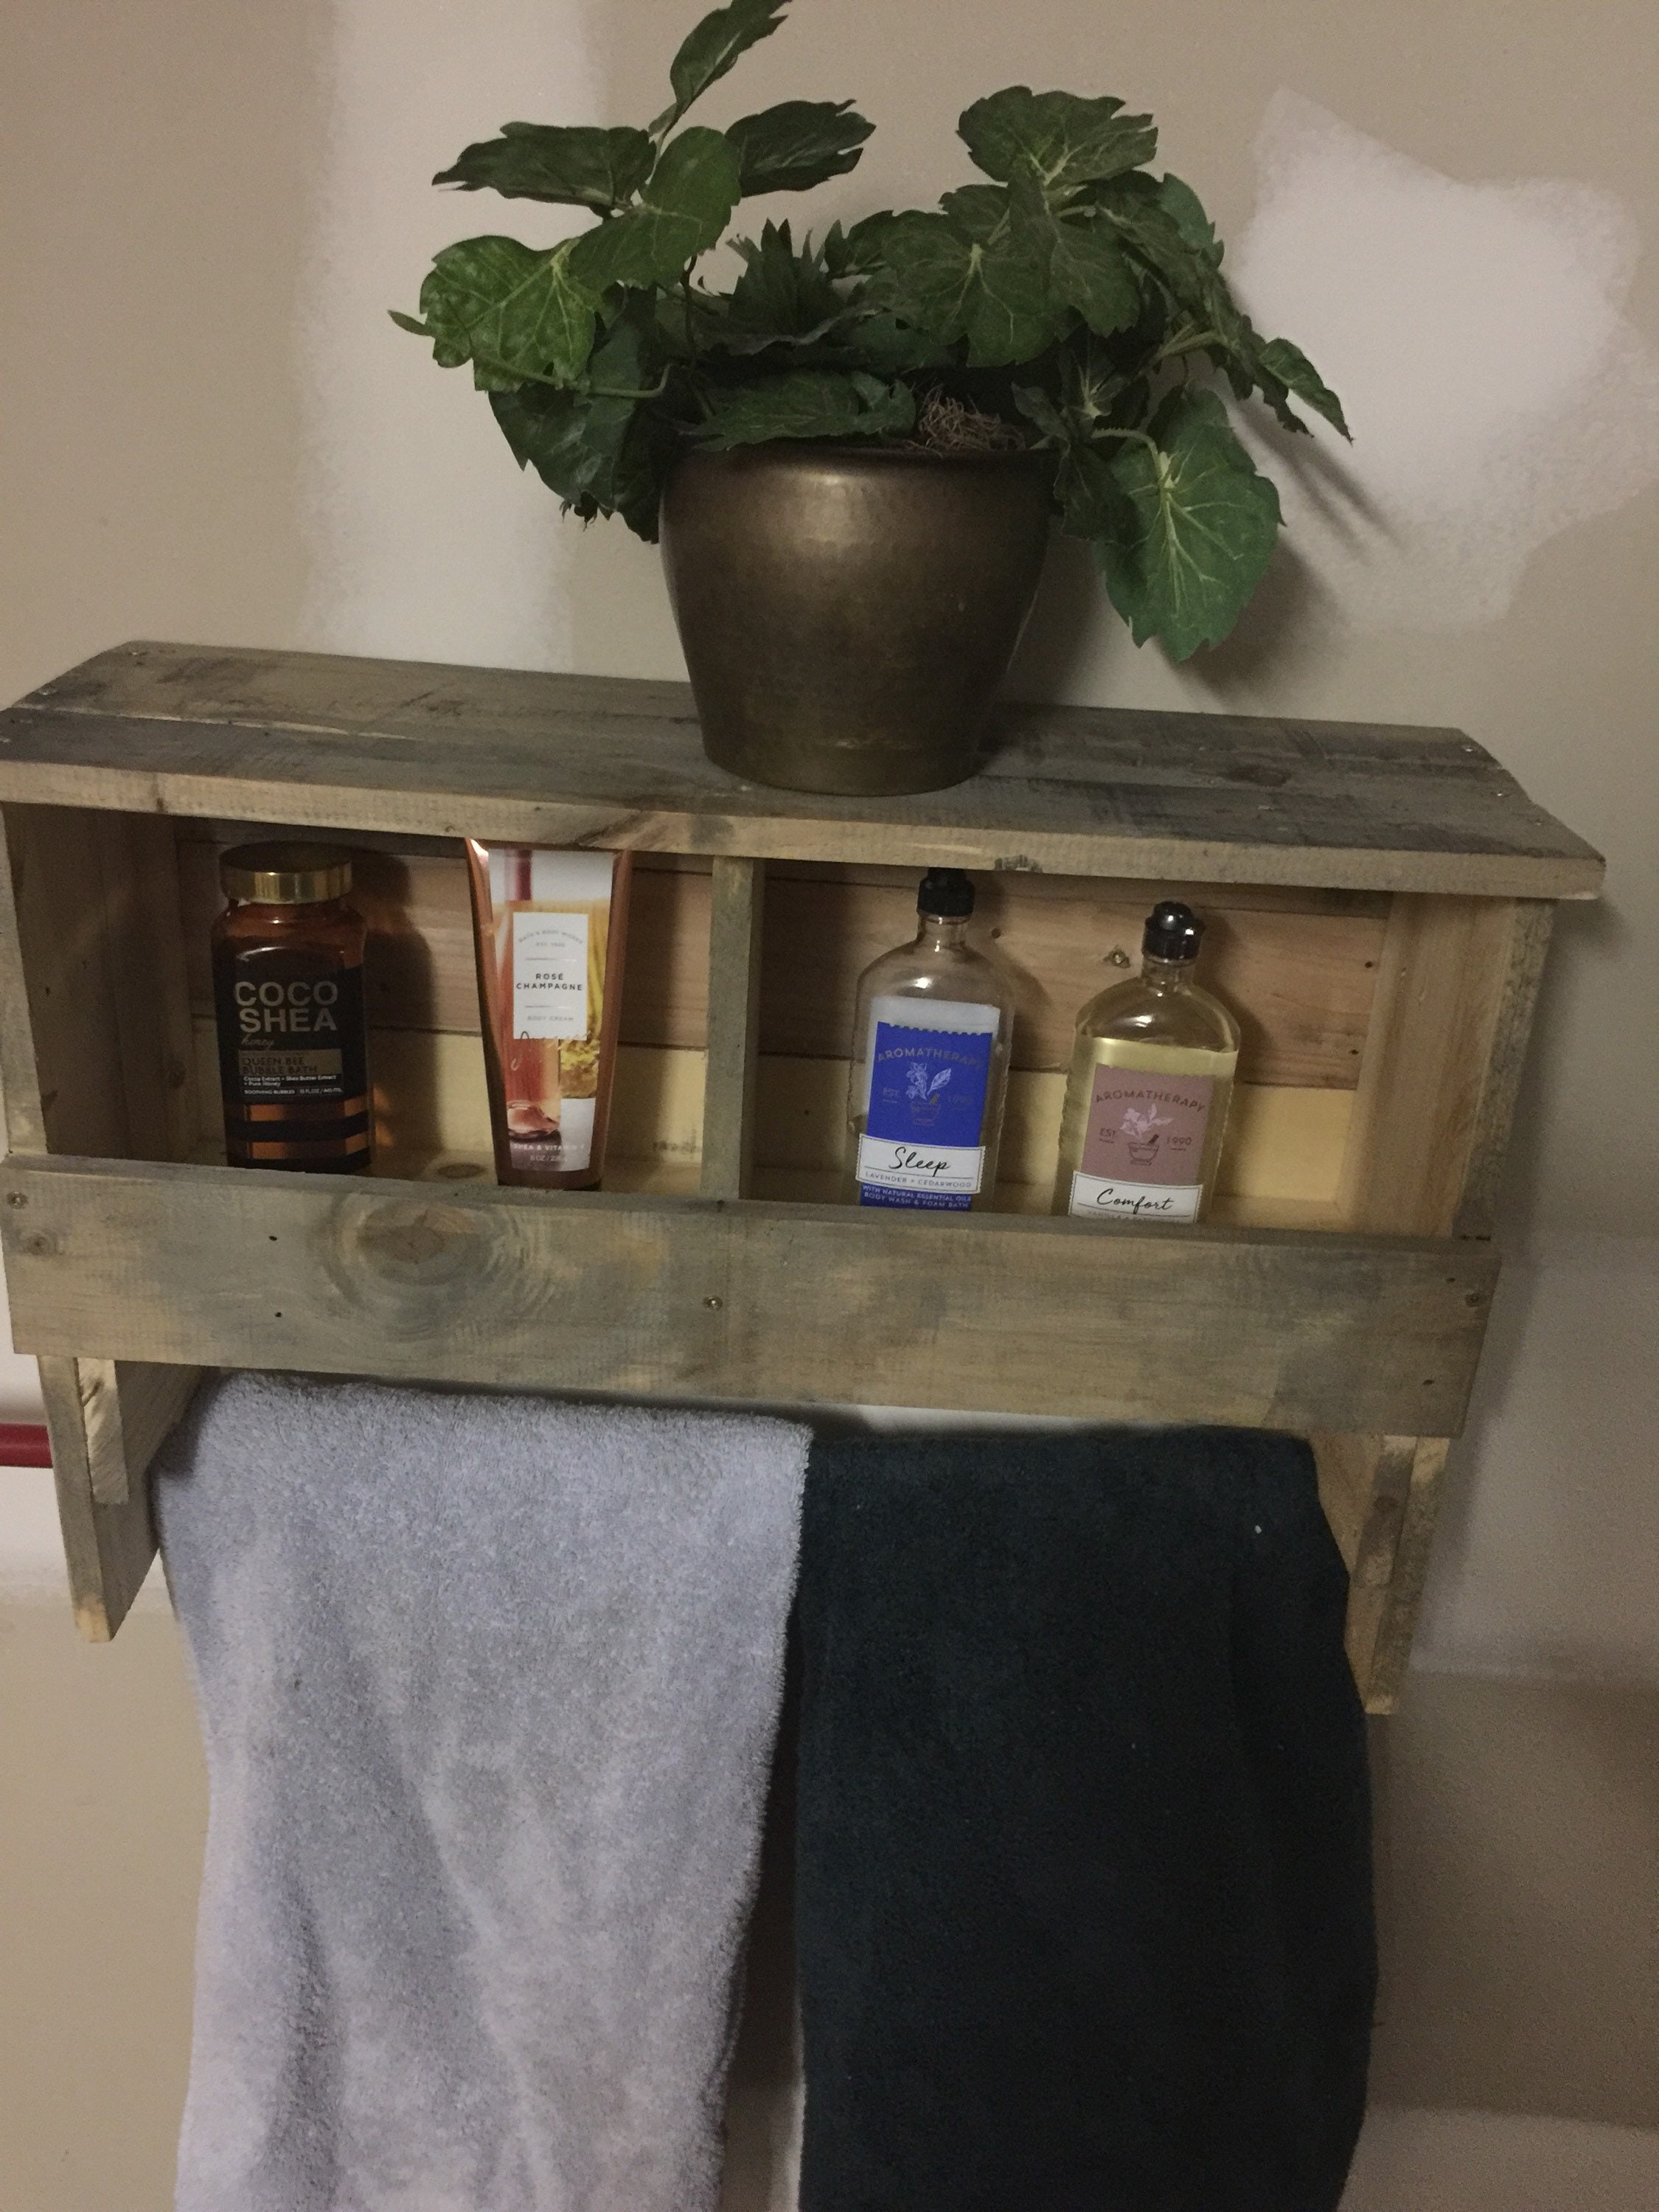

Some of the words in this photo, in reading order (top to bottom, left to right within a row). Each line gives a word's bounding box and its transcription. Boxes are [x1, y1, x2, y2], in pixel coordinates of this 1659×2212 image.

[535, 973, 563, 981] ROSÉ
[234, 981, 338, 1006] COCO
[516, 983, 582, 991] CHAMPAGNE
[239, 1007, 338, 1033] SHEA
[243, 1057, 281, 1065] QUEEN
[285, 1057, 305, 1065] BEE
[878, 1047, 983, 1068] AROMATHERAPY
[288, 1065, 318, 1074] BATH
[1096, 1090, 1206, 1113] AROMATHERAPY
[888, 1146, 950, 1178] Sleep
[866, 1172, 907, 1183] LAVENDER
[917, 1180, 972, 1188] CEDARWOOD
[863, 1184, 880, 1193] WITH
[883, 1188, 914, 1198] NATURAL
[917, 1193, 953, 1201] ESSENTIAL
[864, 1192, 885, 1201] BODY
[888, 1196, 911, 1204] WASH
[922, 1200, 946, 1208] FOAM
[1096, 1188, 1175, 1215] Comfort
